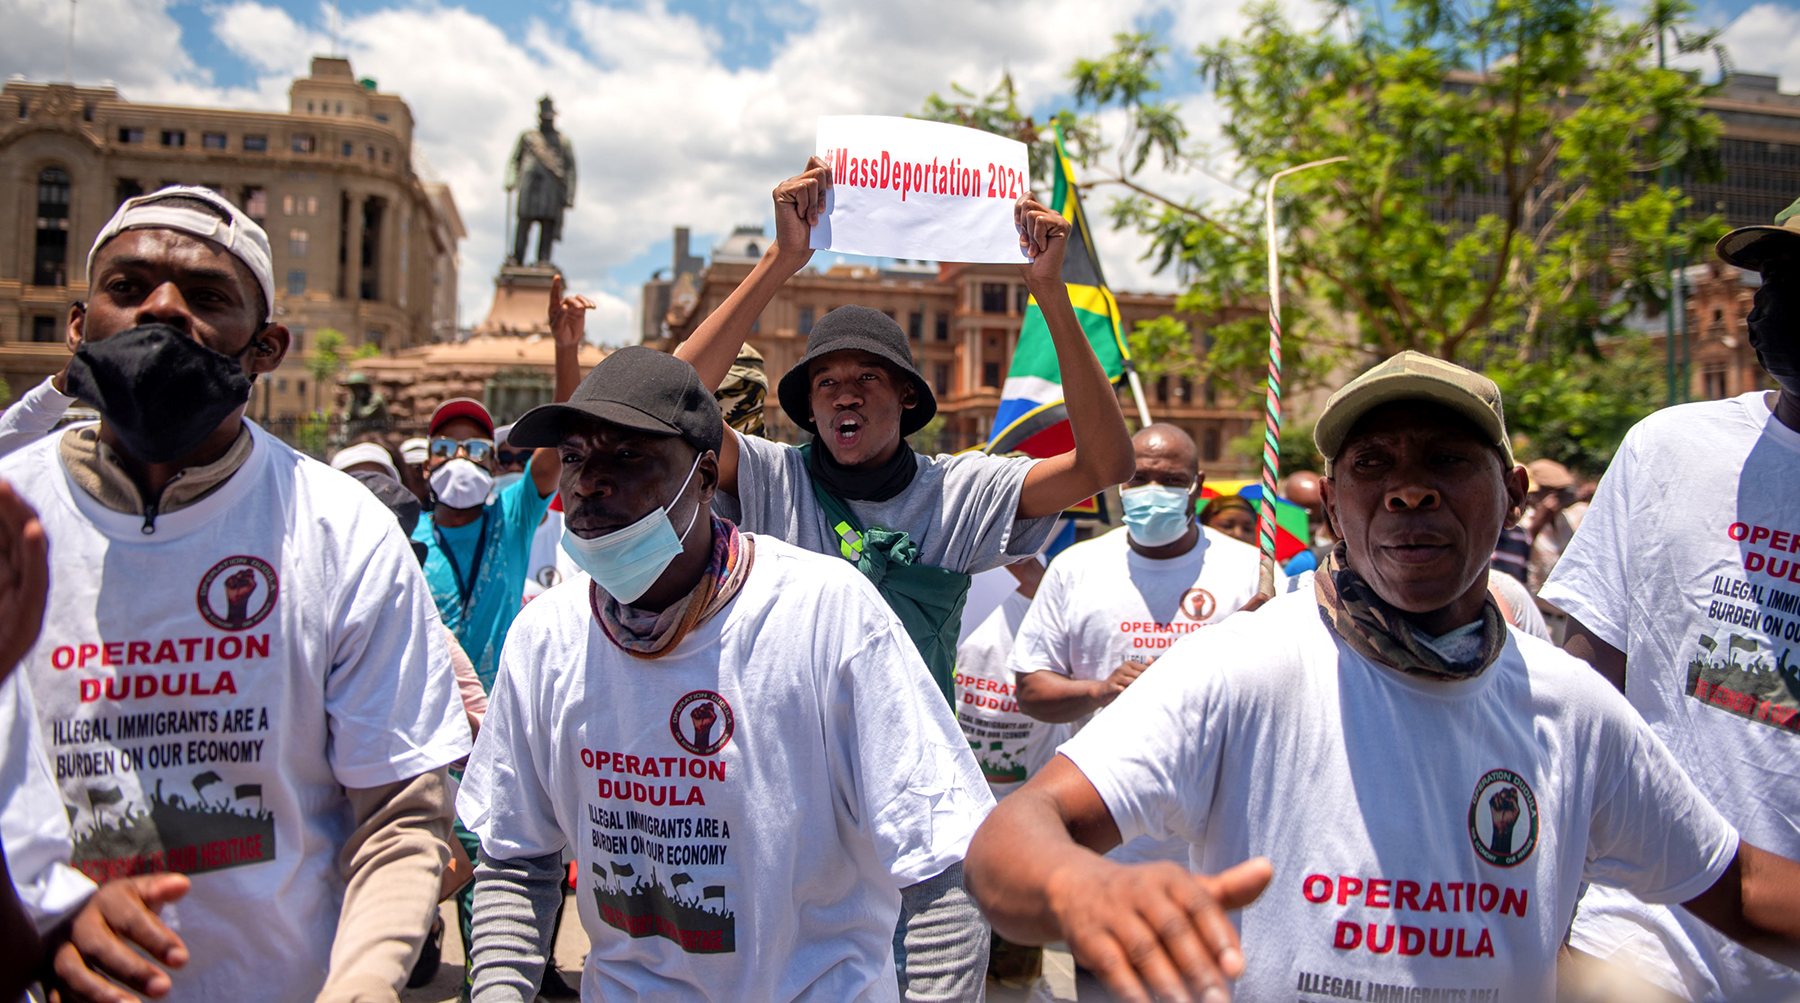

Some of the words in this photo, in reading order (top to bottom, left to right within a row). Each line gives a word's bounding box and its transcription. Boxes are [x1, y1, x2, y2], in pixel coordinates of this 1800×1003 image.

[825, 148, 981, 201] #MassDeportation
[988, 163, 1024, 199] 2021
[1712, 575, 1764, 605] ILLEGAL
[1121, 621, 1214, 634] OPERATIO
[1708, 600, 1761, 630] BURDEN
[1763, 615, 1784, 637] ON
[51, 634, 271, 671] OPERATION
[80, 670, 237, 703] DUDULA
[672, 693, 708, 723] OPERATION
[711, 694, 732, 724] DUDULA
[1709, 684, 1759, 715] ECONOMY
[1758, 700, 1771, 720] IS
[1771, 704, 1797, 729] OUR
[53, 716, 111, 746] ILLEGAL
[117, 709, 218, 740] IMMIGRANTS
[222, 708, 254, 734] ARE
[258, 707, 269, 731] A
[56, 751, 115, 779] BURDEN
[121, 747, 144, 773] ON
[148, 743, 182, 769] OUR
[187, 739, 264, 765] ECONOMY
[580, 748, 726, 782] OPERATION
[598, 778, 706, 806] DUDULA
[1473, 771, 1511, 804] OPERATION
[1513, 776, 1537, 818] DUDULA
[588, 803, 623, 830] ILLEGAL
[626, 811, 692, 839] IMMIGRANTS
[695, 817, 719, 839] ARE
[722, 820, 730, 839] A
[168, 845, 197, 873] OUR
[201, 834, 263, 869] HERITAGE
[592, 829, 628, 854] BURDEN
[631, 835, 646, 855] ON
[646, 840, 664, 864] OUR
[667, 845, 727, 866] ECONOMY
[1302, 874, 1528, 918] OPERATION
[1333, 921, 1495, 958] DUDULA
[1297, 971, 1362, 1001] ILLEGAL
[1366, 981, 1466, 1003] IMMIGRANTS
